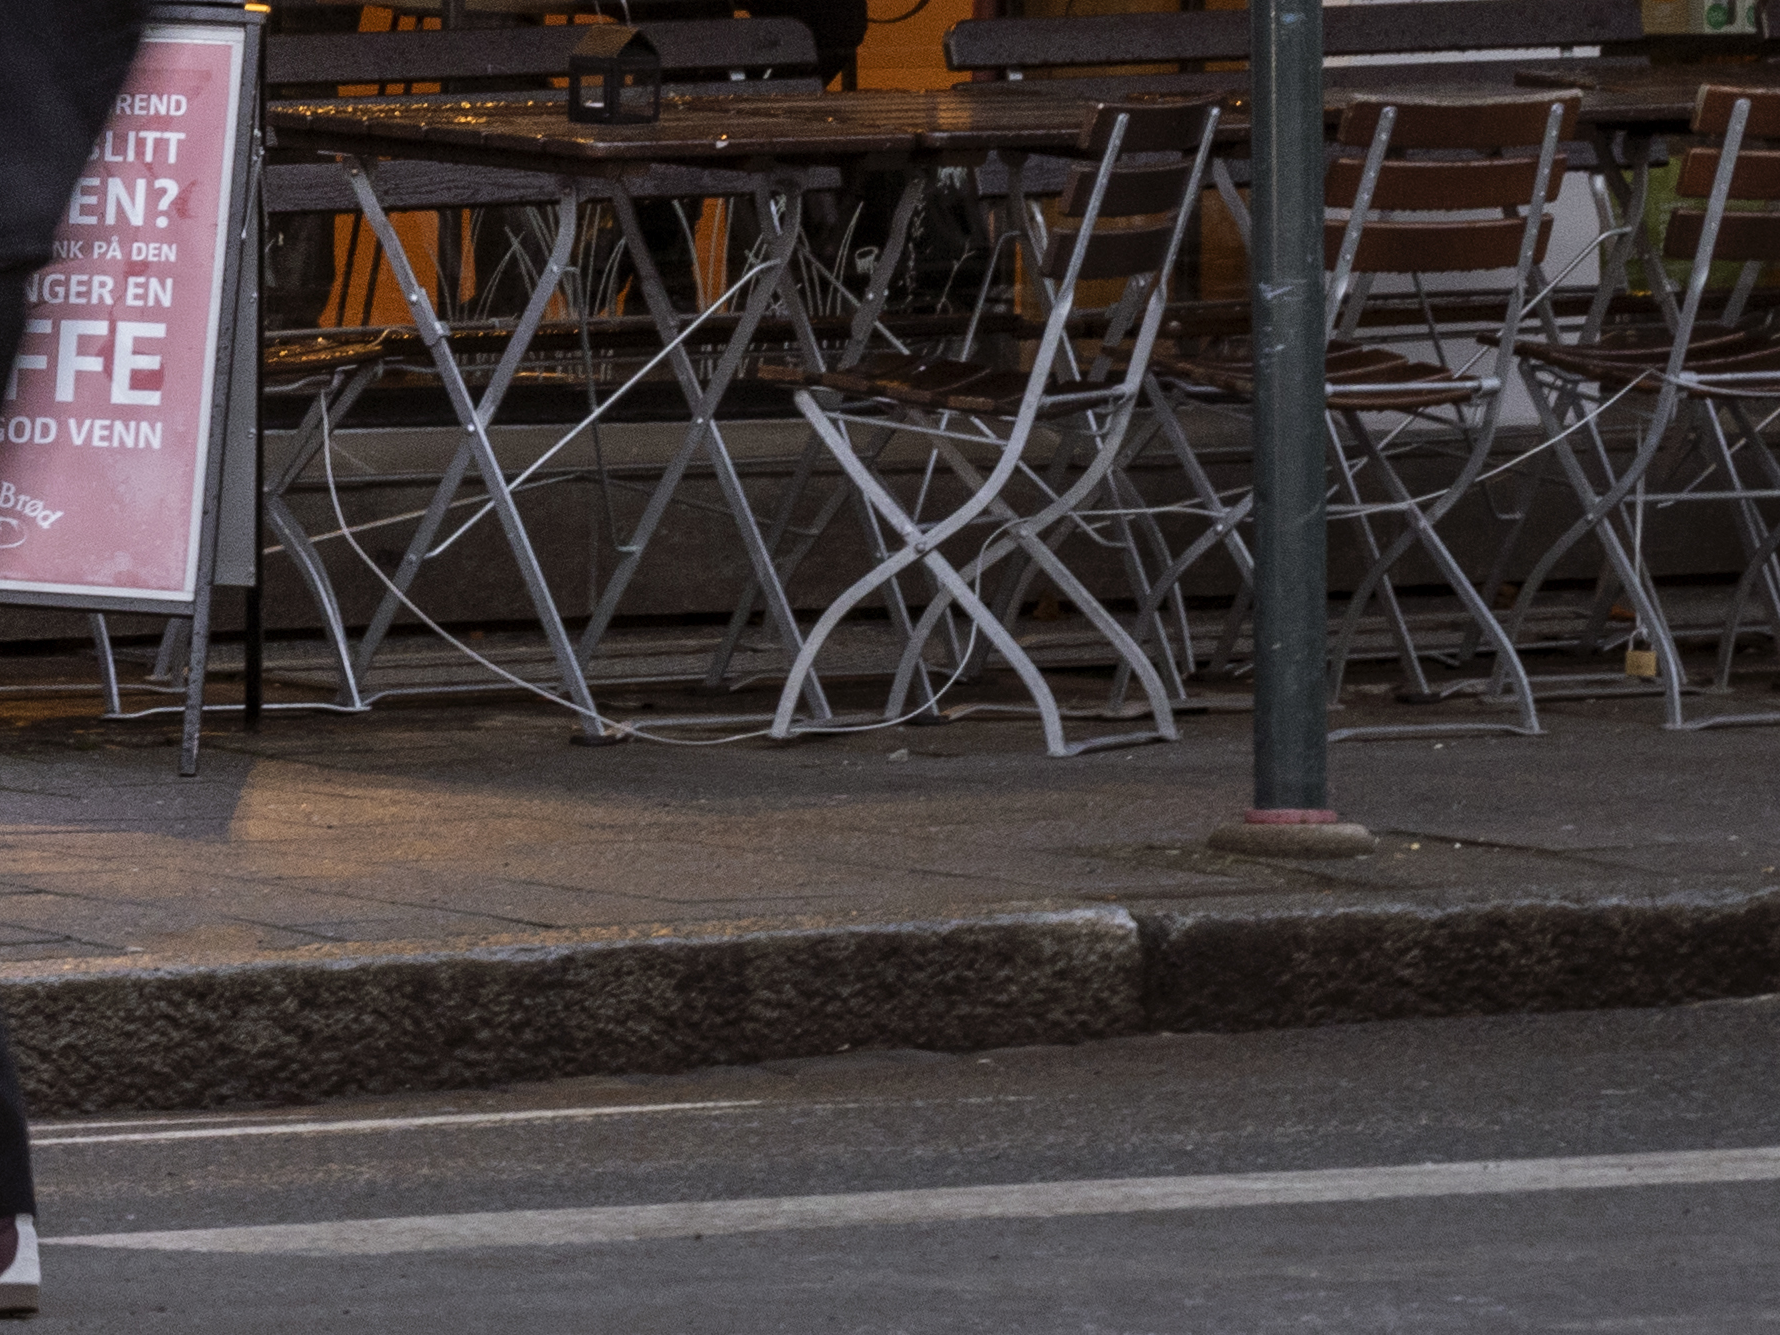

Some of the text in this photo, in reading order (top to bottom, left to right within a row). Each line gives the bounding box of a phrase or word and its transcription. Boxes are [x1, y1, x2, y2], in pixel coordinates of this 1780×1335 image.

[67, 176, 180, 229] EN?
[92, 234, 123, 261] PÅ
[130, 241, 178, 263] DEN
[125, 276, 174, 308] EN
[67, 417, 164, 450] VENN
